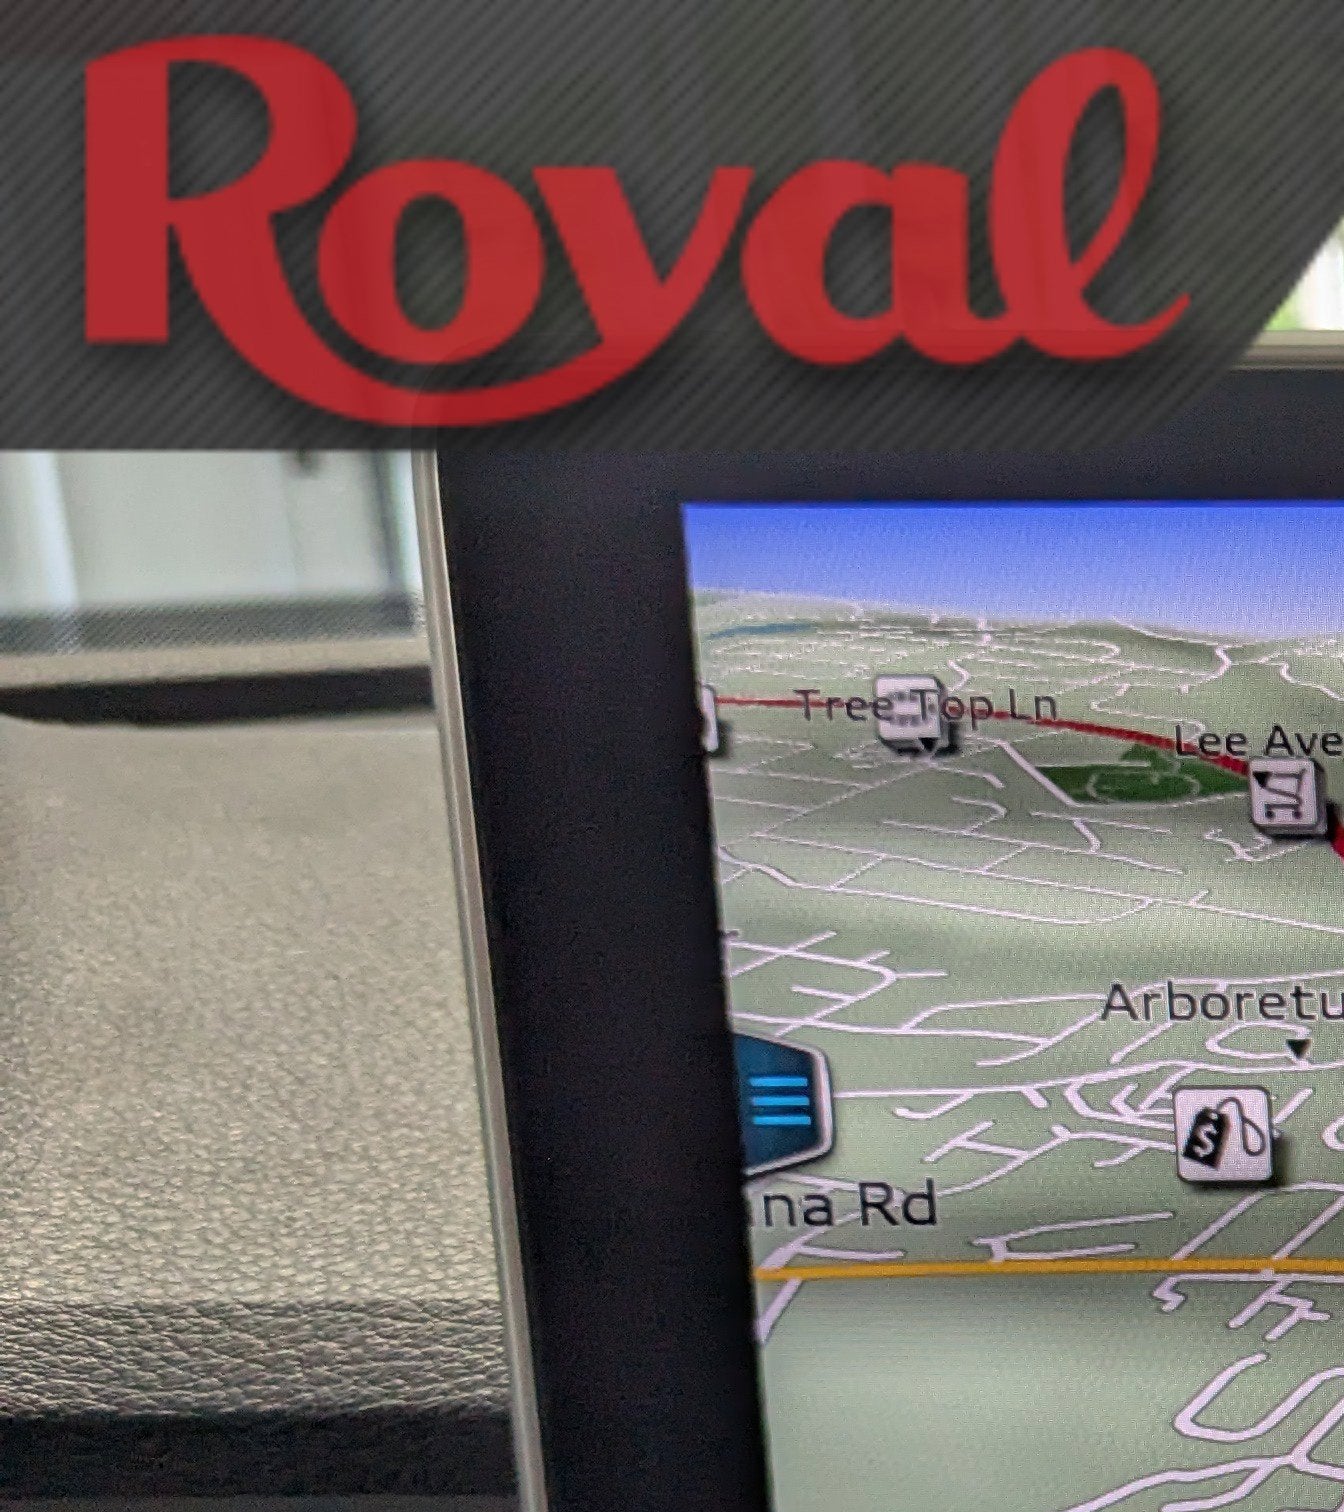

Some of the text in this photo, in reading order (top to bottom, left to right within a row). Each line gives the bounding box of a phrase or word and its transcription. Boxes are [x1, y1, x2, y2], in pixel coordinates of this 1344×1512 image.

[793, 687, 1058, 731] Tree Top Ln
[1176, 724, 1344, 757] Lee Ave
[858, 1177, 938, 1227] Rd
